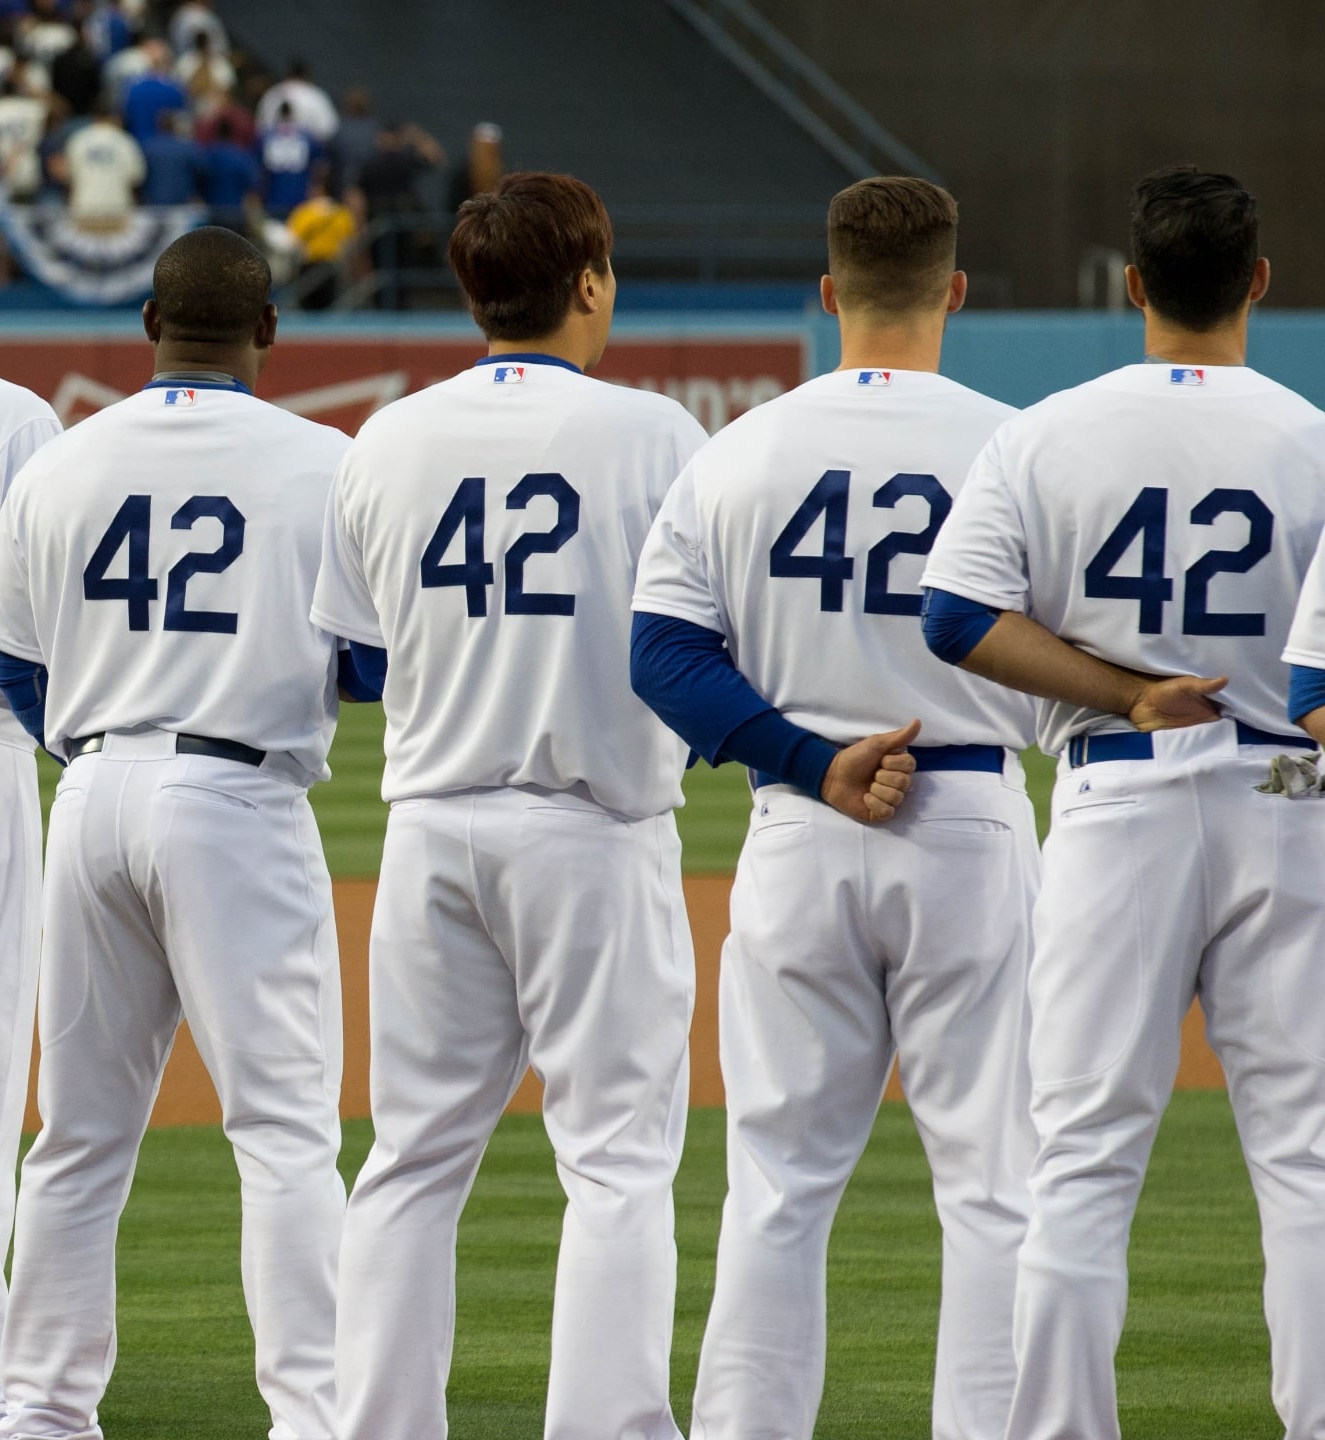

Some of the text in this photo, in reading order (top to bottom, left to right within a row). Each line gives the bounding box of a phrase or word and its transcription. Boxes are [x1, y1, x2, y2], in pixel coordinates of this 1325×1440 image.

[83, 494, 246, 634] 42
[420, 473, 582, 617] 42
[770, 470, 953, 614] 42
[1084, 487, 1275, 636] 42
